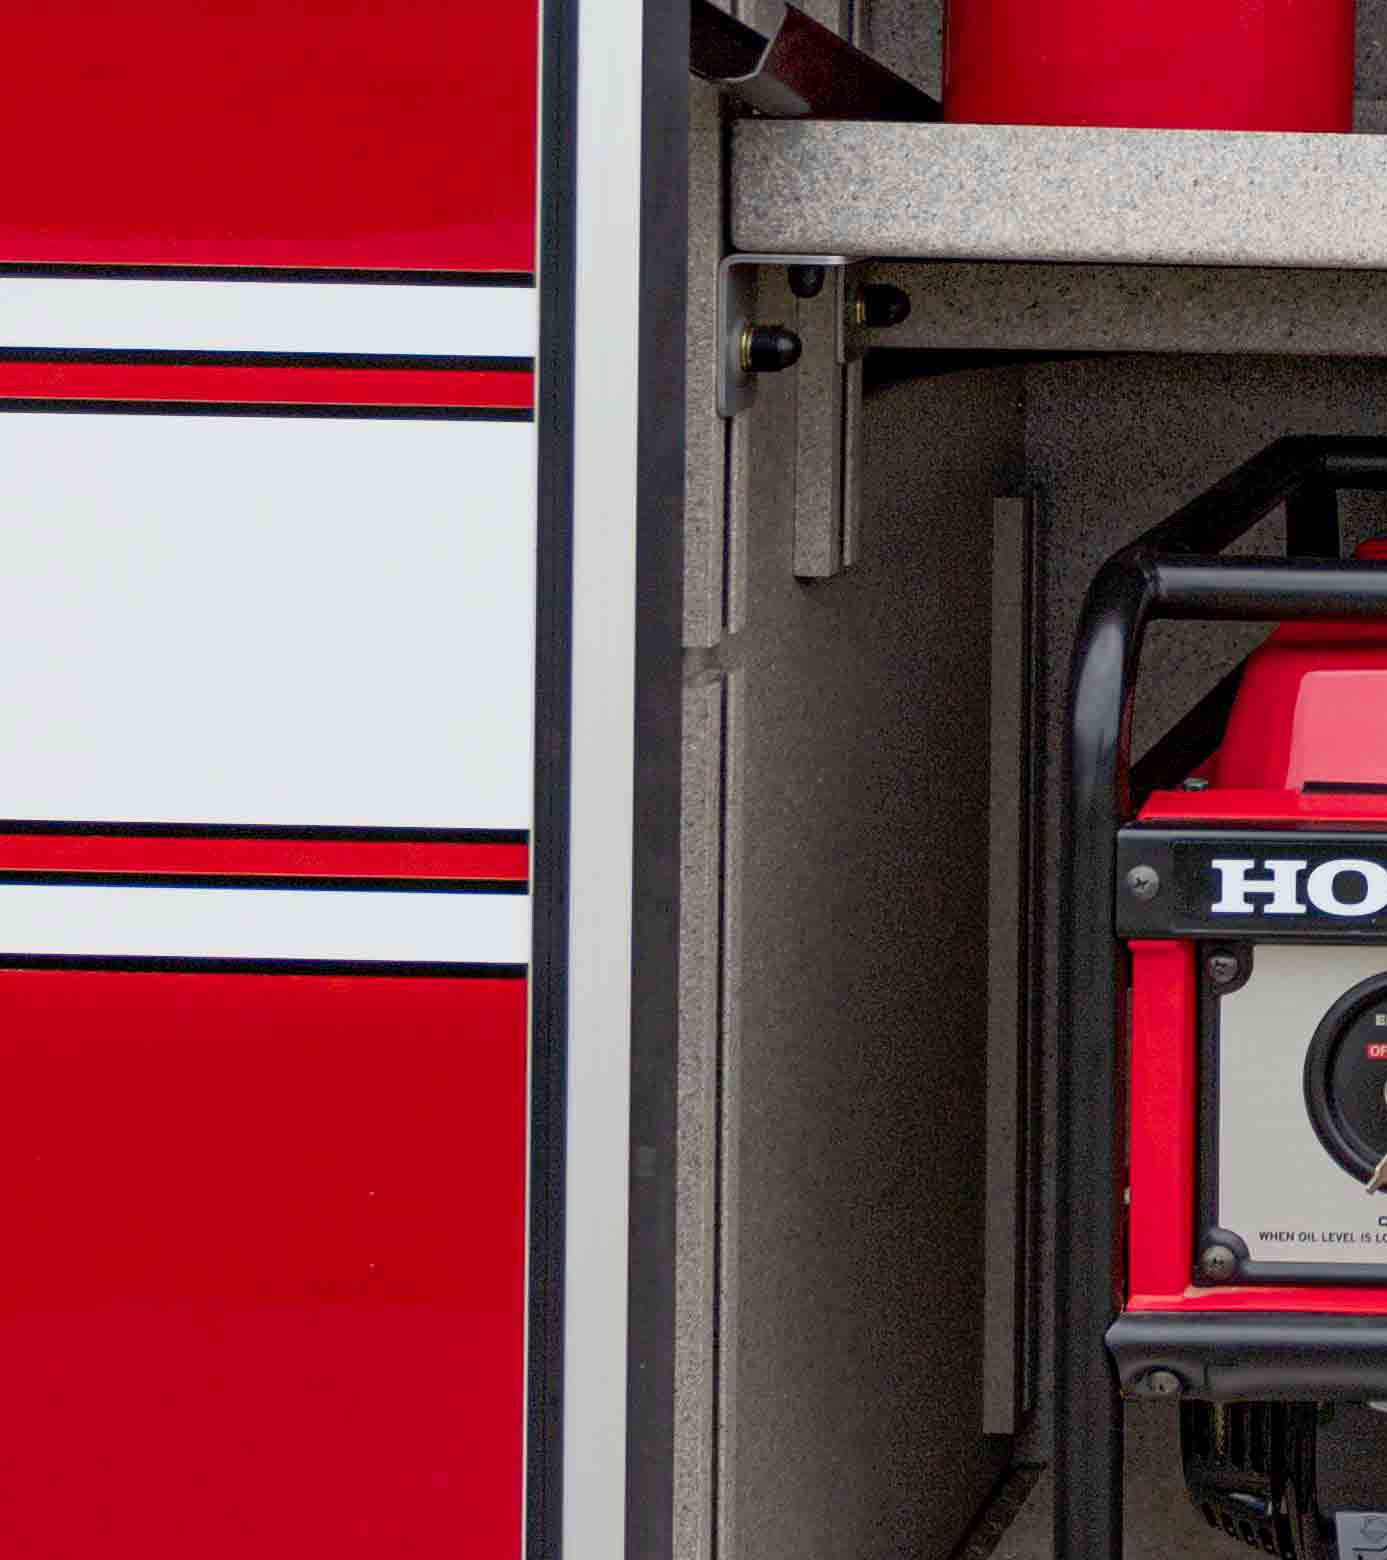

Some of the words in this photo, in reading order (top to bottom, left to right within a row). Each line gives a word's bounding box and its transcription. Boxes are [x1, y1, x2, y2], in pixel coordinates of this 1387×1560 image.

[1258, 1231, 1295, 1241] WHEN
[1298, 1232, 1319, 1242] OIL
[1322, 1232, 1357, 1243] LEVEL
[1361, 1232, 1373, 1243] IS
